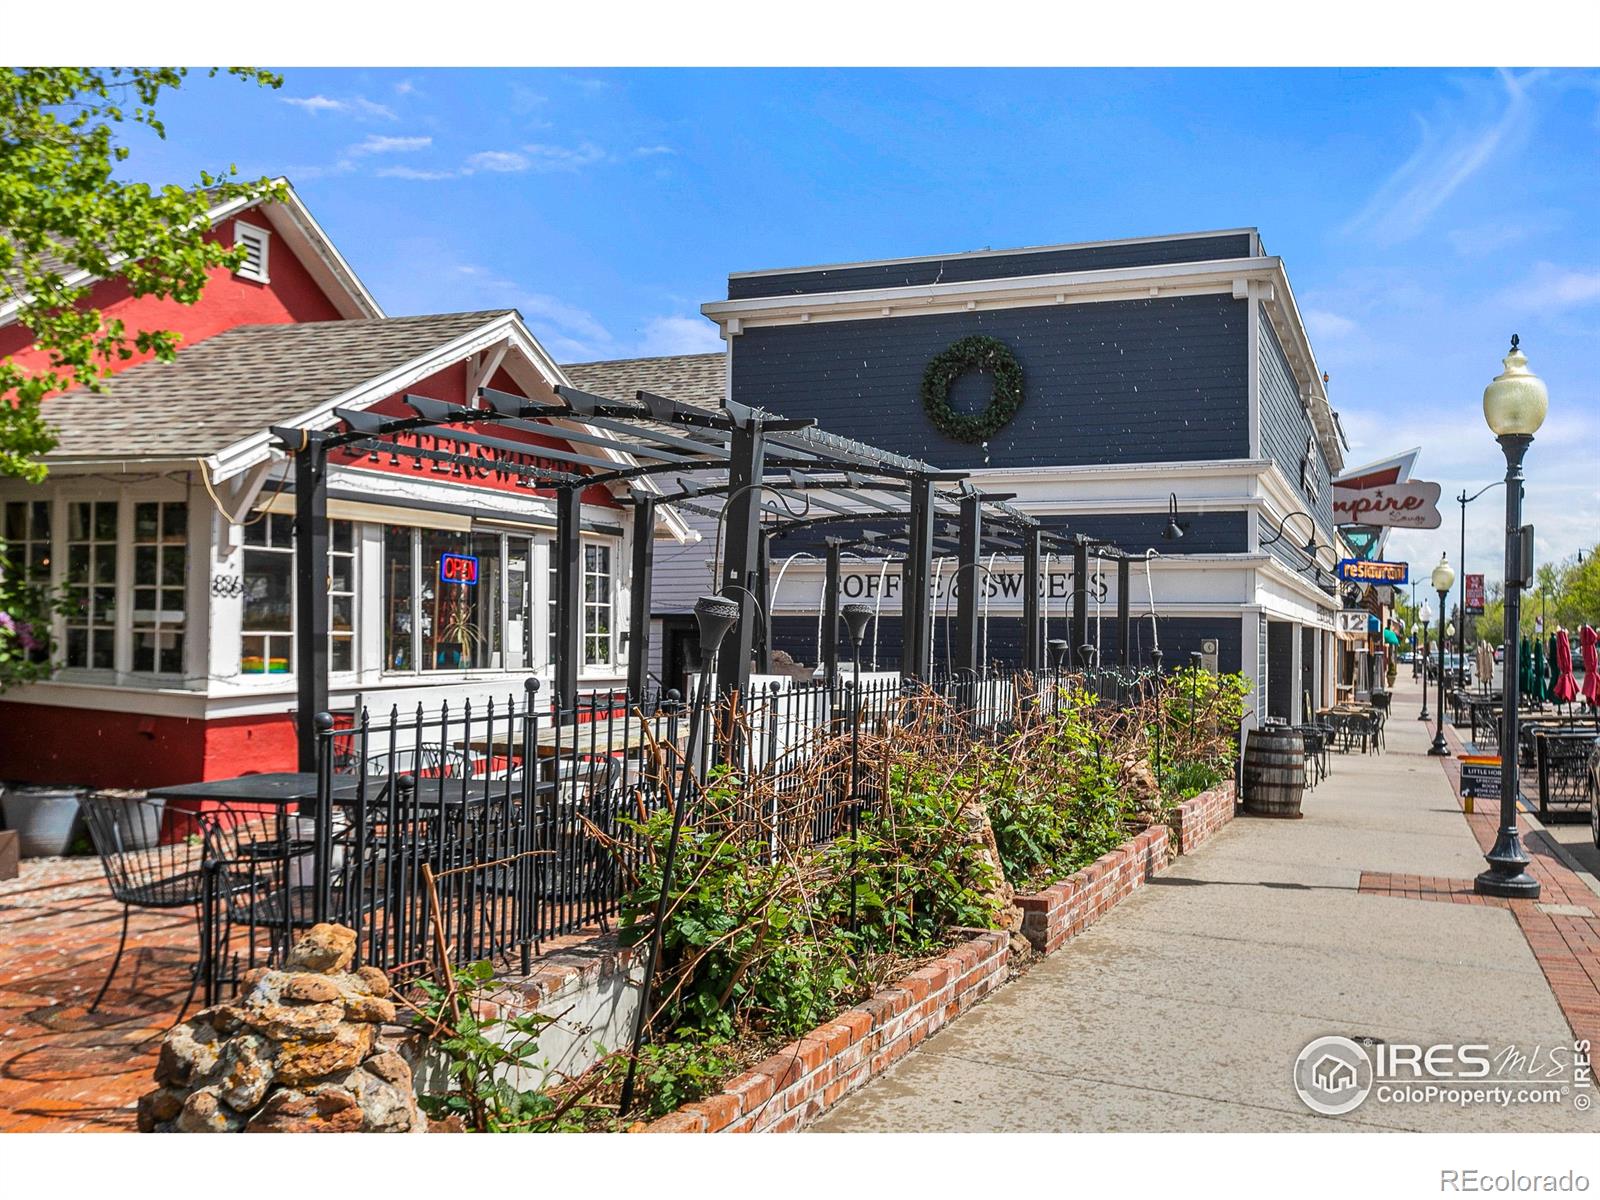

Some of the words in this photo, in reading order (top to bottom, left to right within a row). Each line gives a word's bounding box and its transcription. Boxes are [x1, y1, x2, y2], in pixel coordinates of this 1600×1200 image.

[1333, 496, 1424, 521] mpire
[445, 557, 473, 581] OPEN
[836, 574, 944, 598] OFFE
